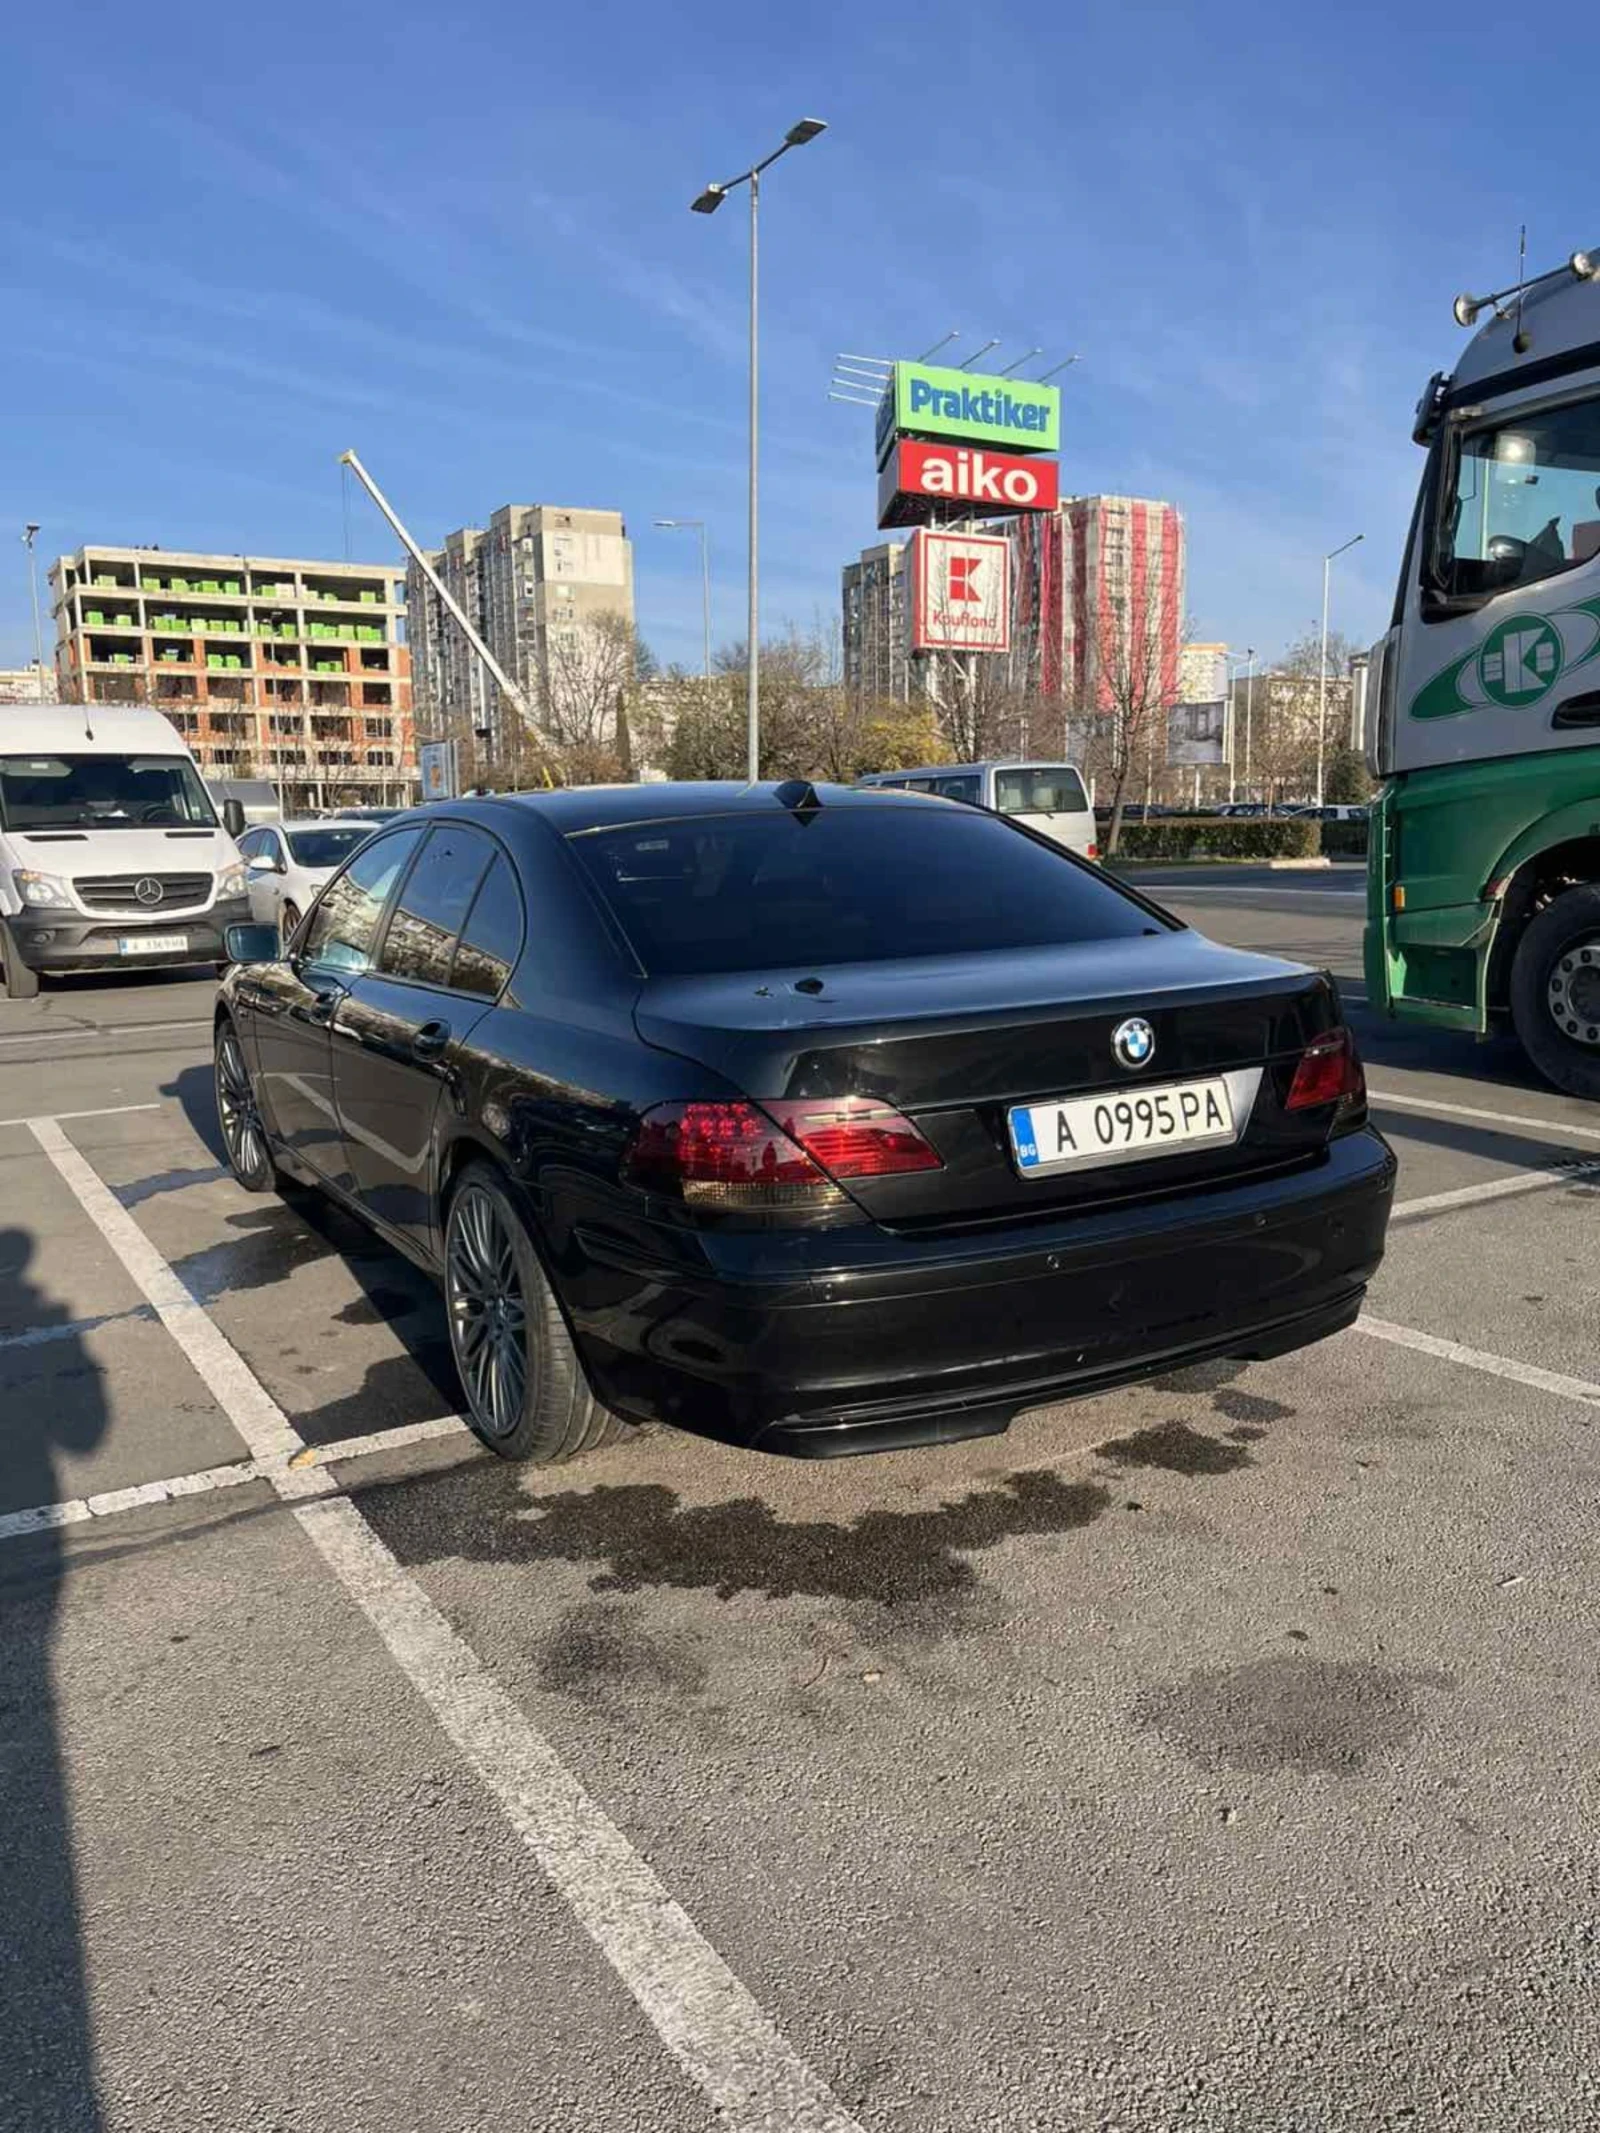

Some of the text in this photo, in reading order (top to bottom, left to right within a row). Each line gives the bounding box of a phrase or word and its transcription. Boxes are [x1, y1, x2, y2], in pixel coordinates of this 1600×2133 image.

[910, 378, 1051, 432] Praktiker
[920, 451, 1038, 503] aiko
[1020, 1143, 1037, 1157] BG
[1056, 1110, 1078, 1153] A
